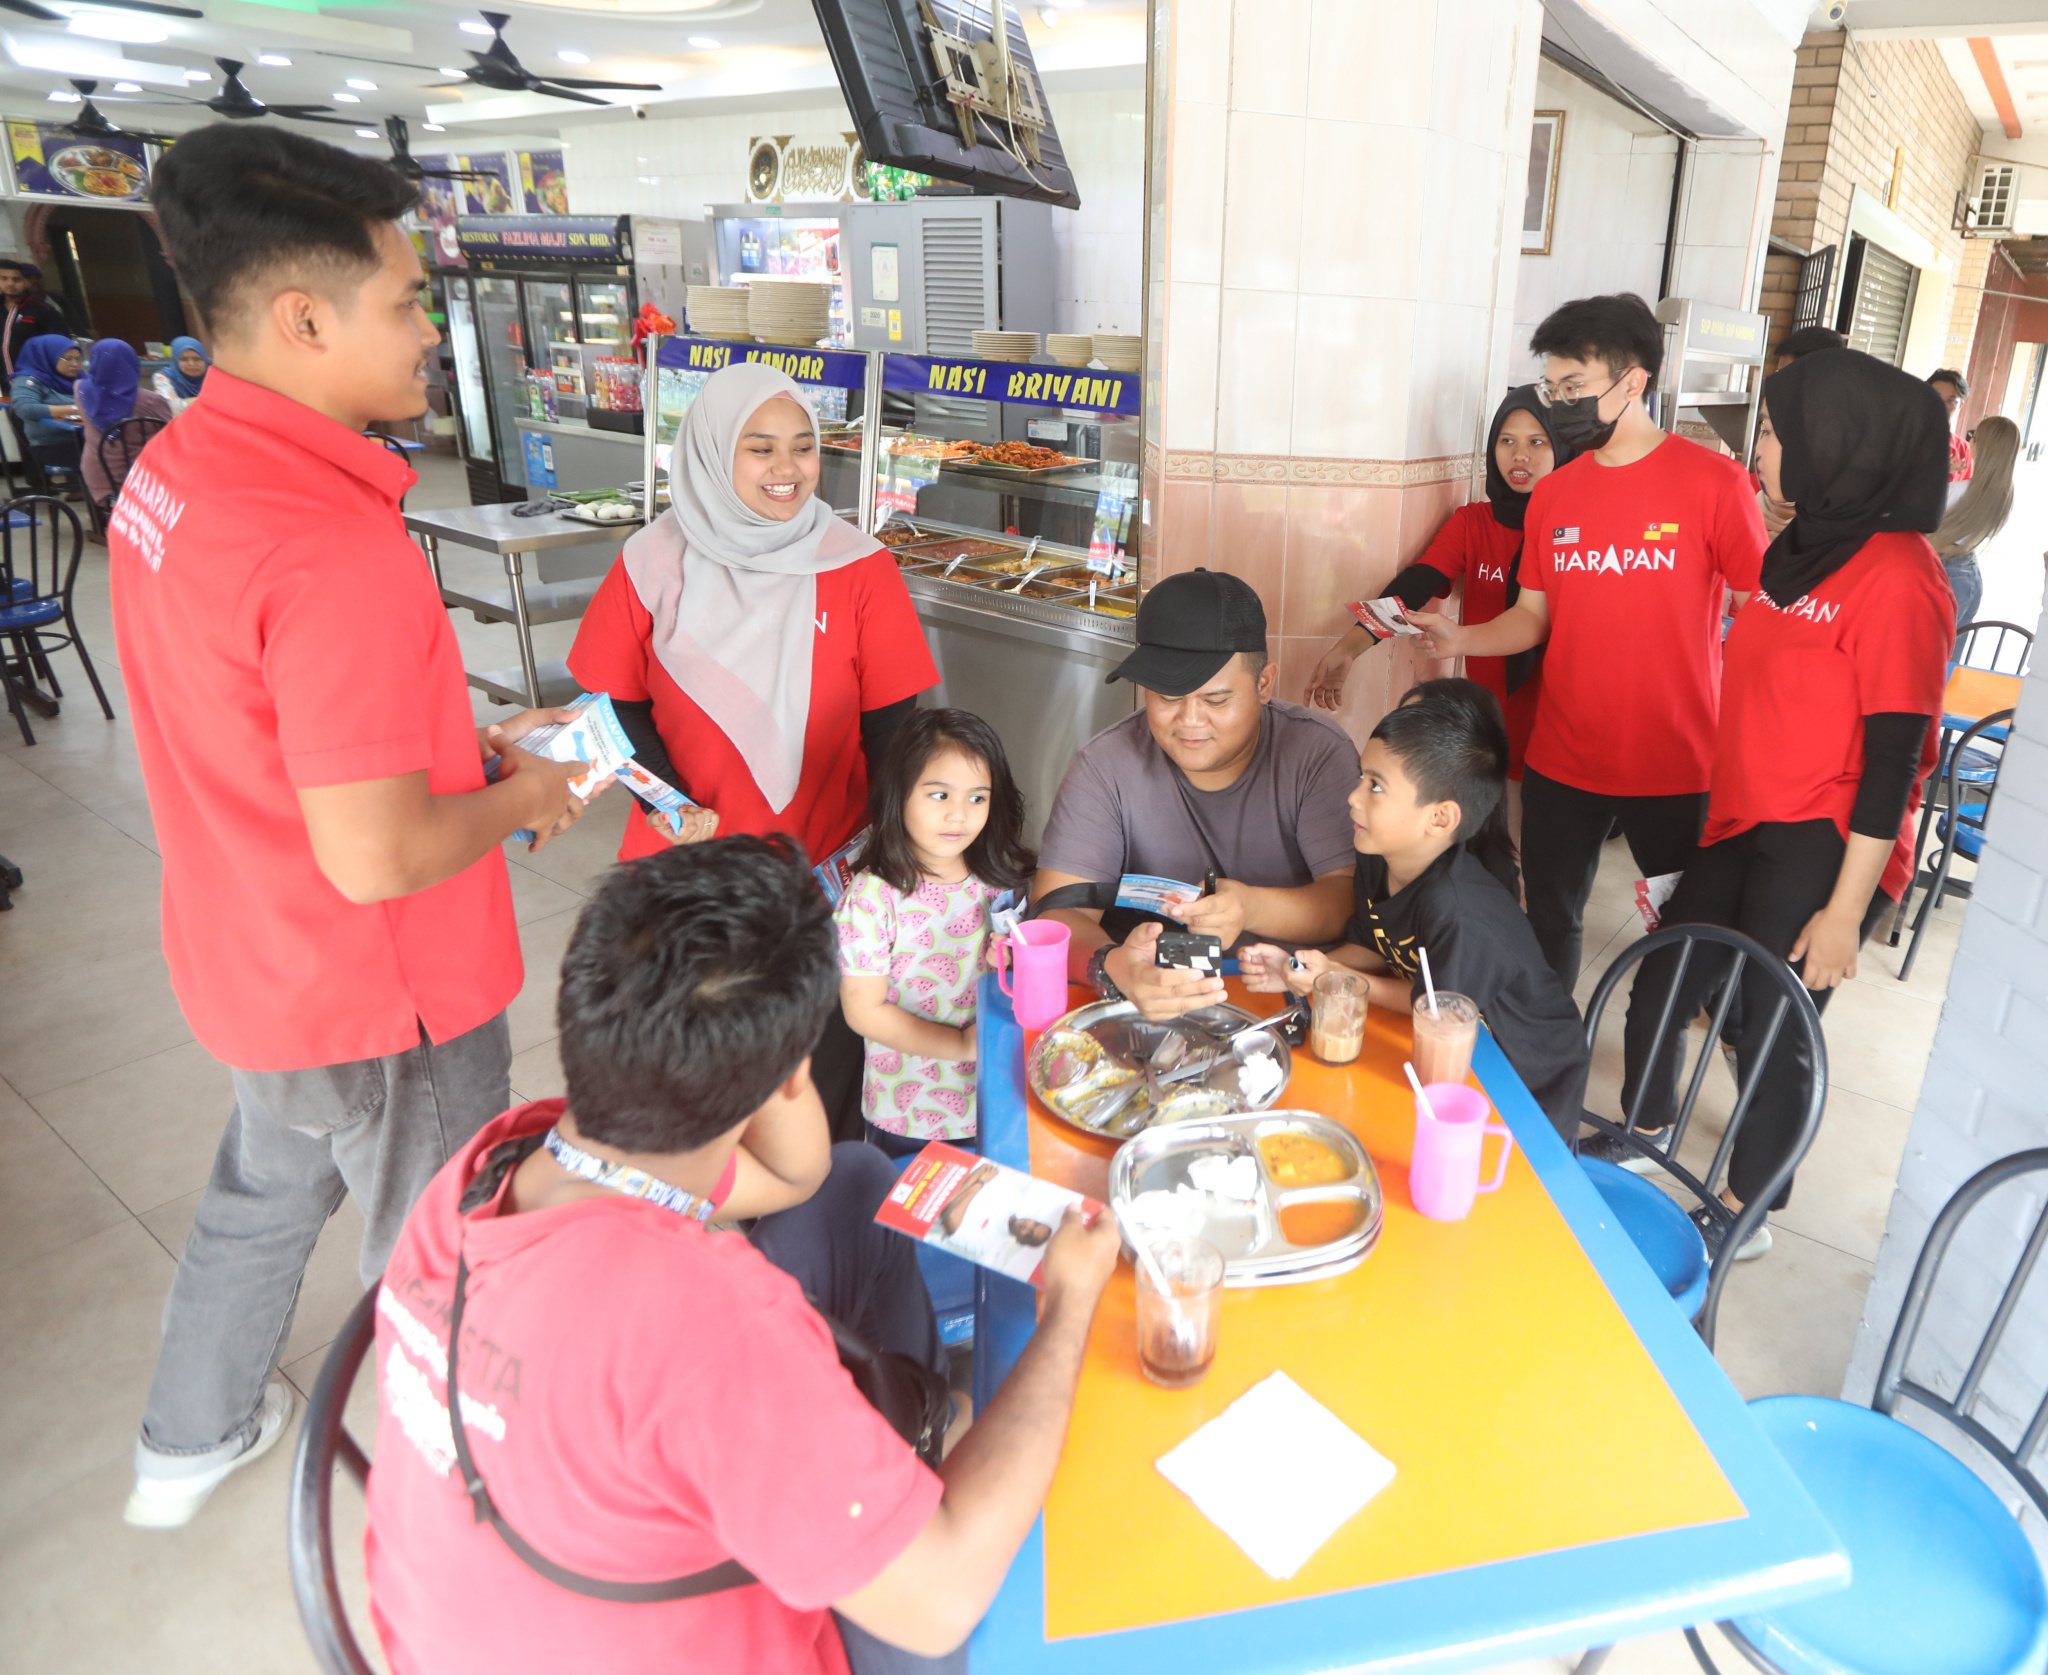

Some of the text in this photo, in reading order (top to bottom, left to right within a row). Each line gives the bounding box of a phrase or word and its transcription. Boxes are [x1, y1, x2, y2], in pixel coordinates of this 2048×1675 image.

[461, 231, 499, 243] RESTORAN
[540, 231, 567, 247] MAJU
[568, 232, 589, 246] SDN.
[589, 233, 611, 247] BHD.
[689, 344, 731, 369] NASI
[928, 364, 1122, 408] NASI BRIYANI
[125, 460, 185, 532] HARAPAN
[1553, 543, 1676, 576] HARAPAN
[602, 703, 628, 750] HARAPAN
[923, 1161, 943, 1180] KITA
[903, 1180, 928, 1211] BOLEH
